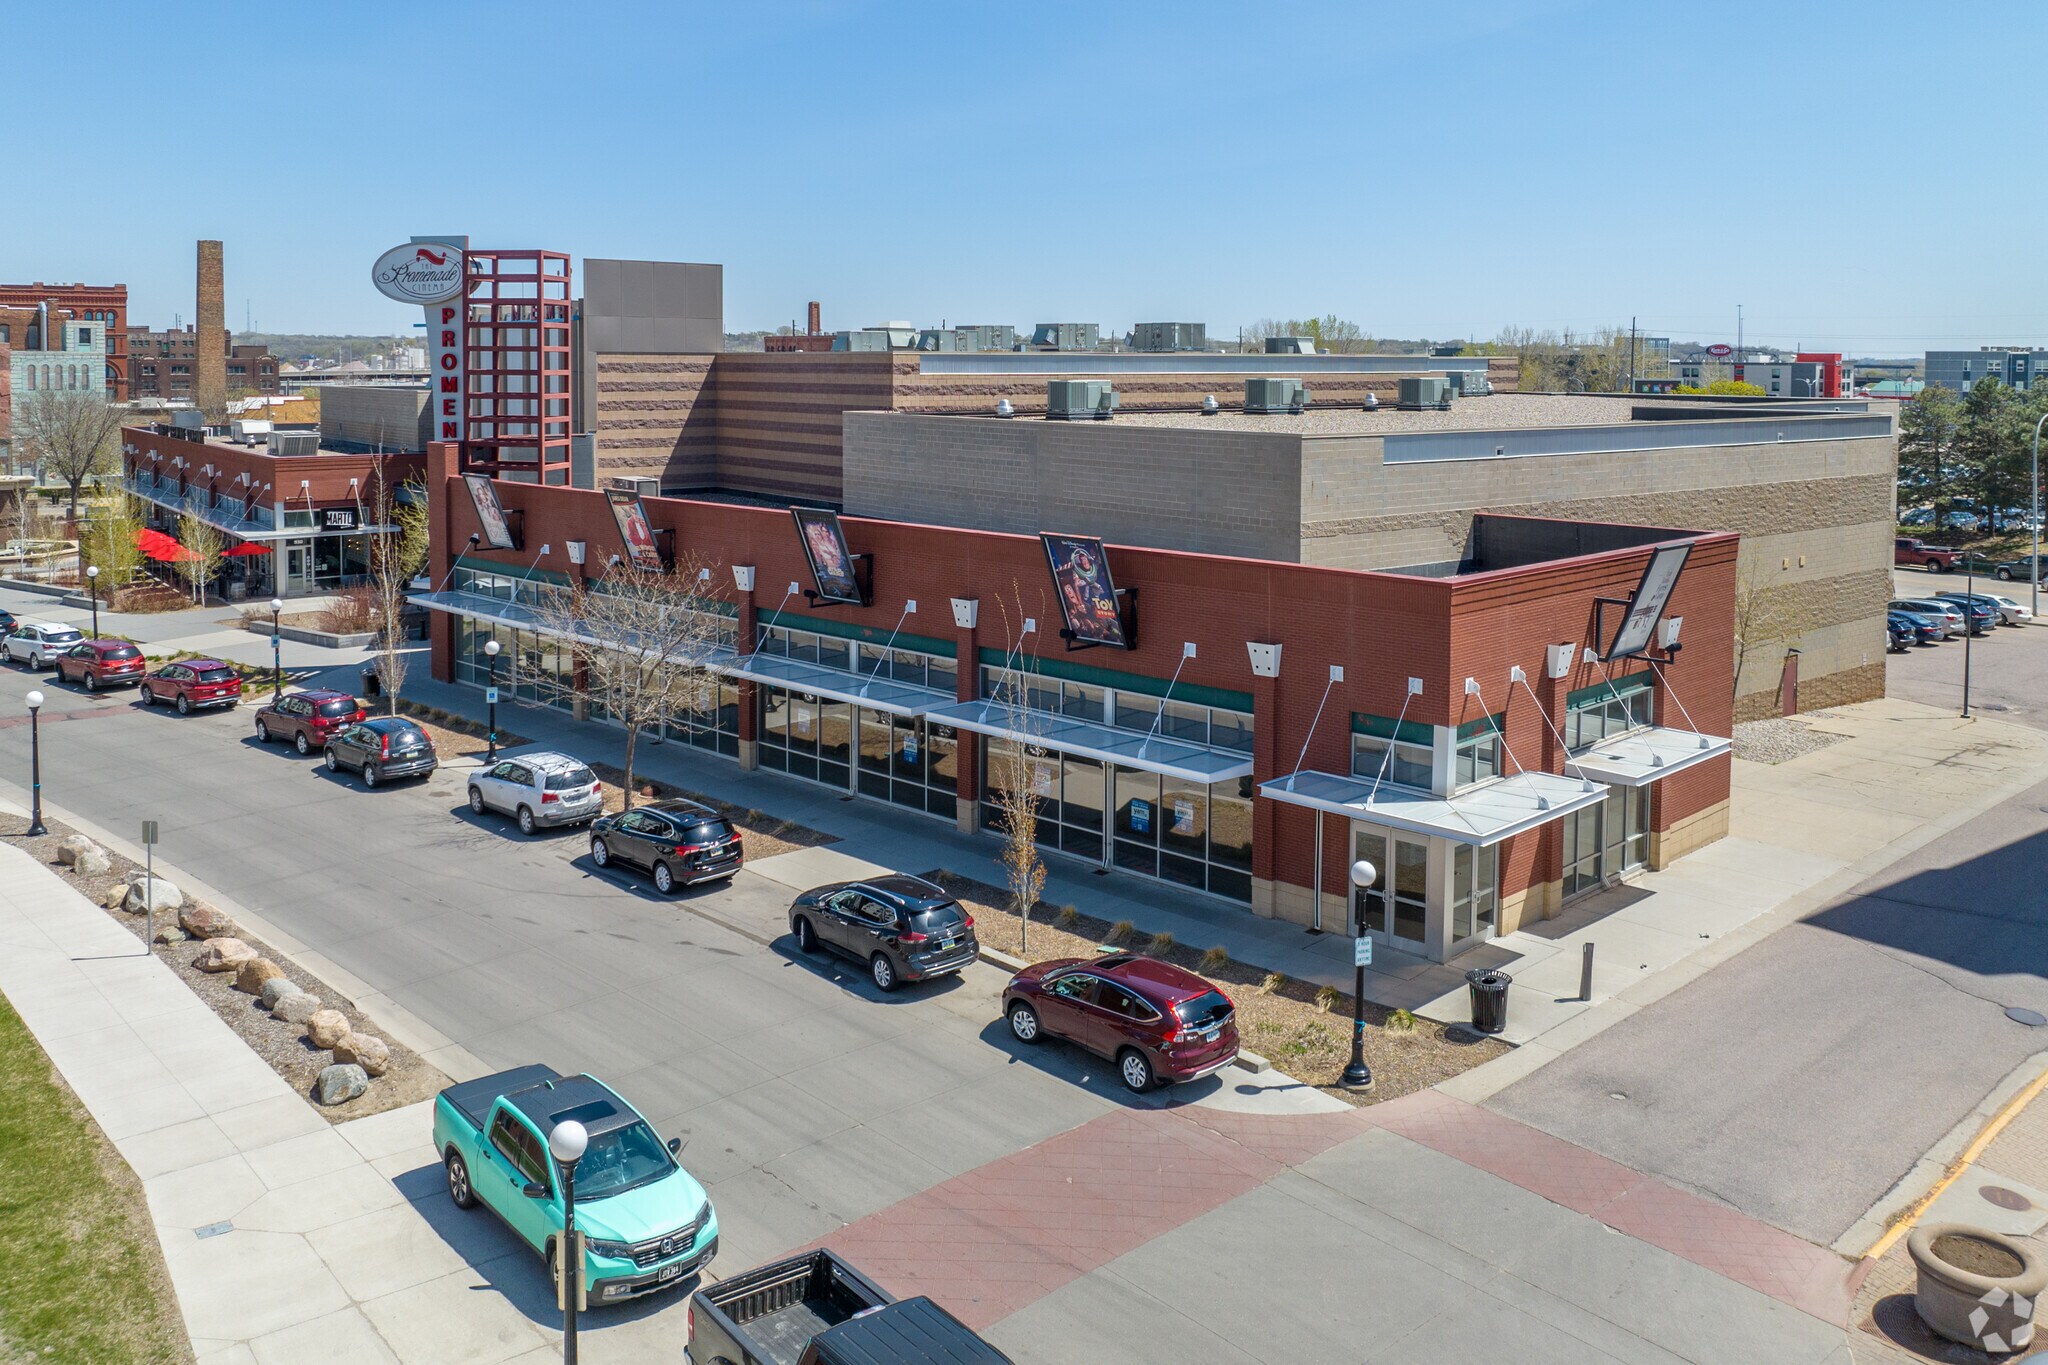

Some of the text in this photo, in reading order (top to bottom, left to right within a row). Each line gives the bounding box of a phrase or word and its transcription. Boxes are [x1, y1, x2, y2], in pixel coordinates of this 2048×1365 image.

[377, 261, 461, 284] Promenade
[412, 283, 445, 292] CINEMA
[1092, 597, 1114, 610] TOY
